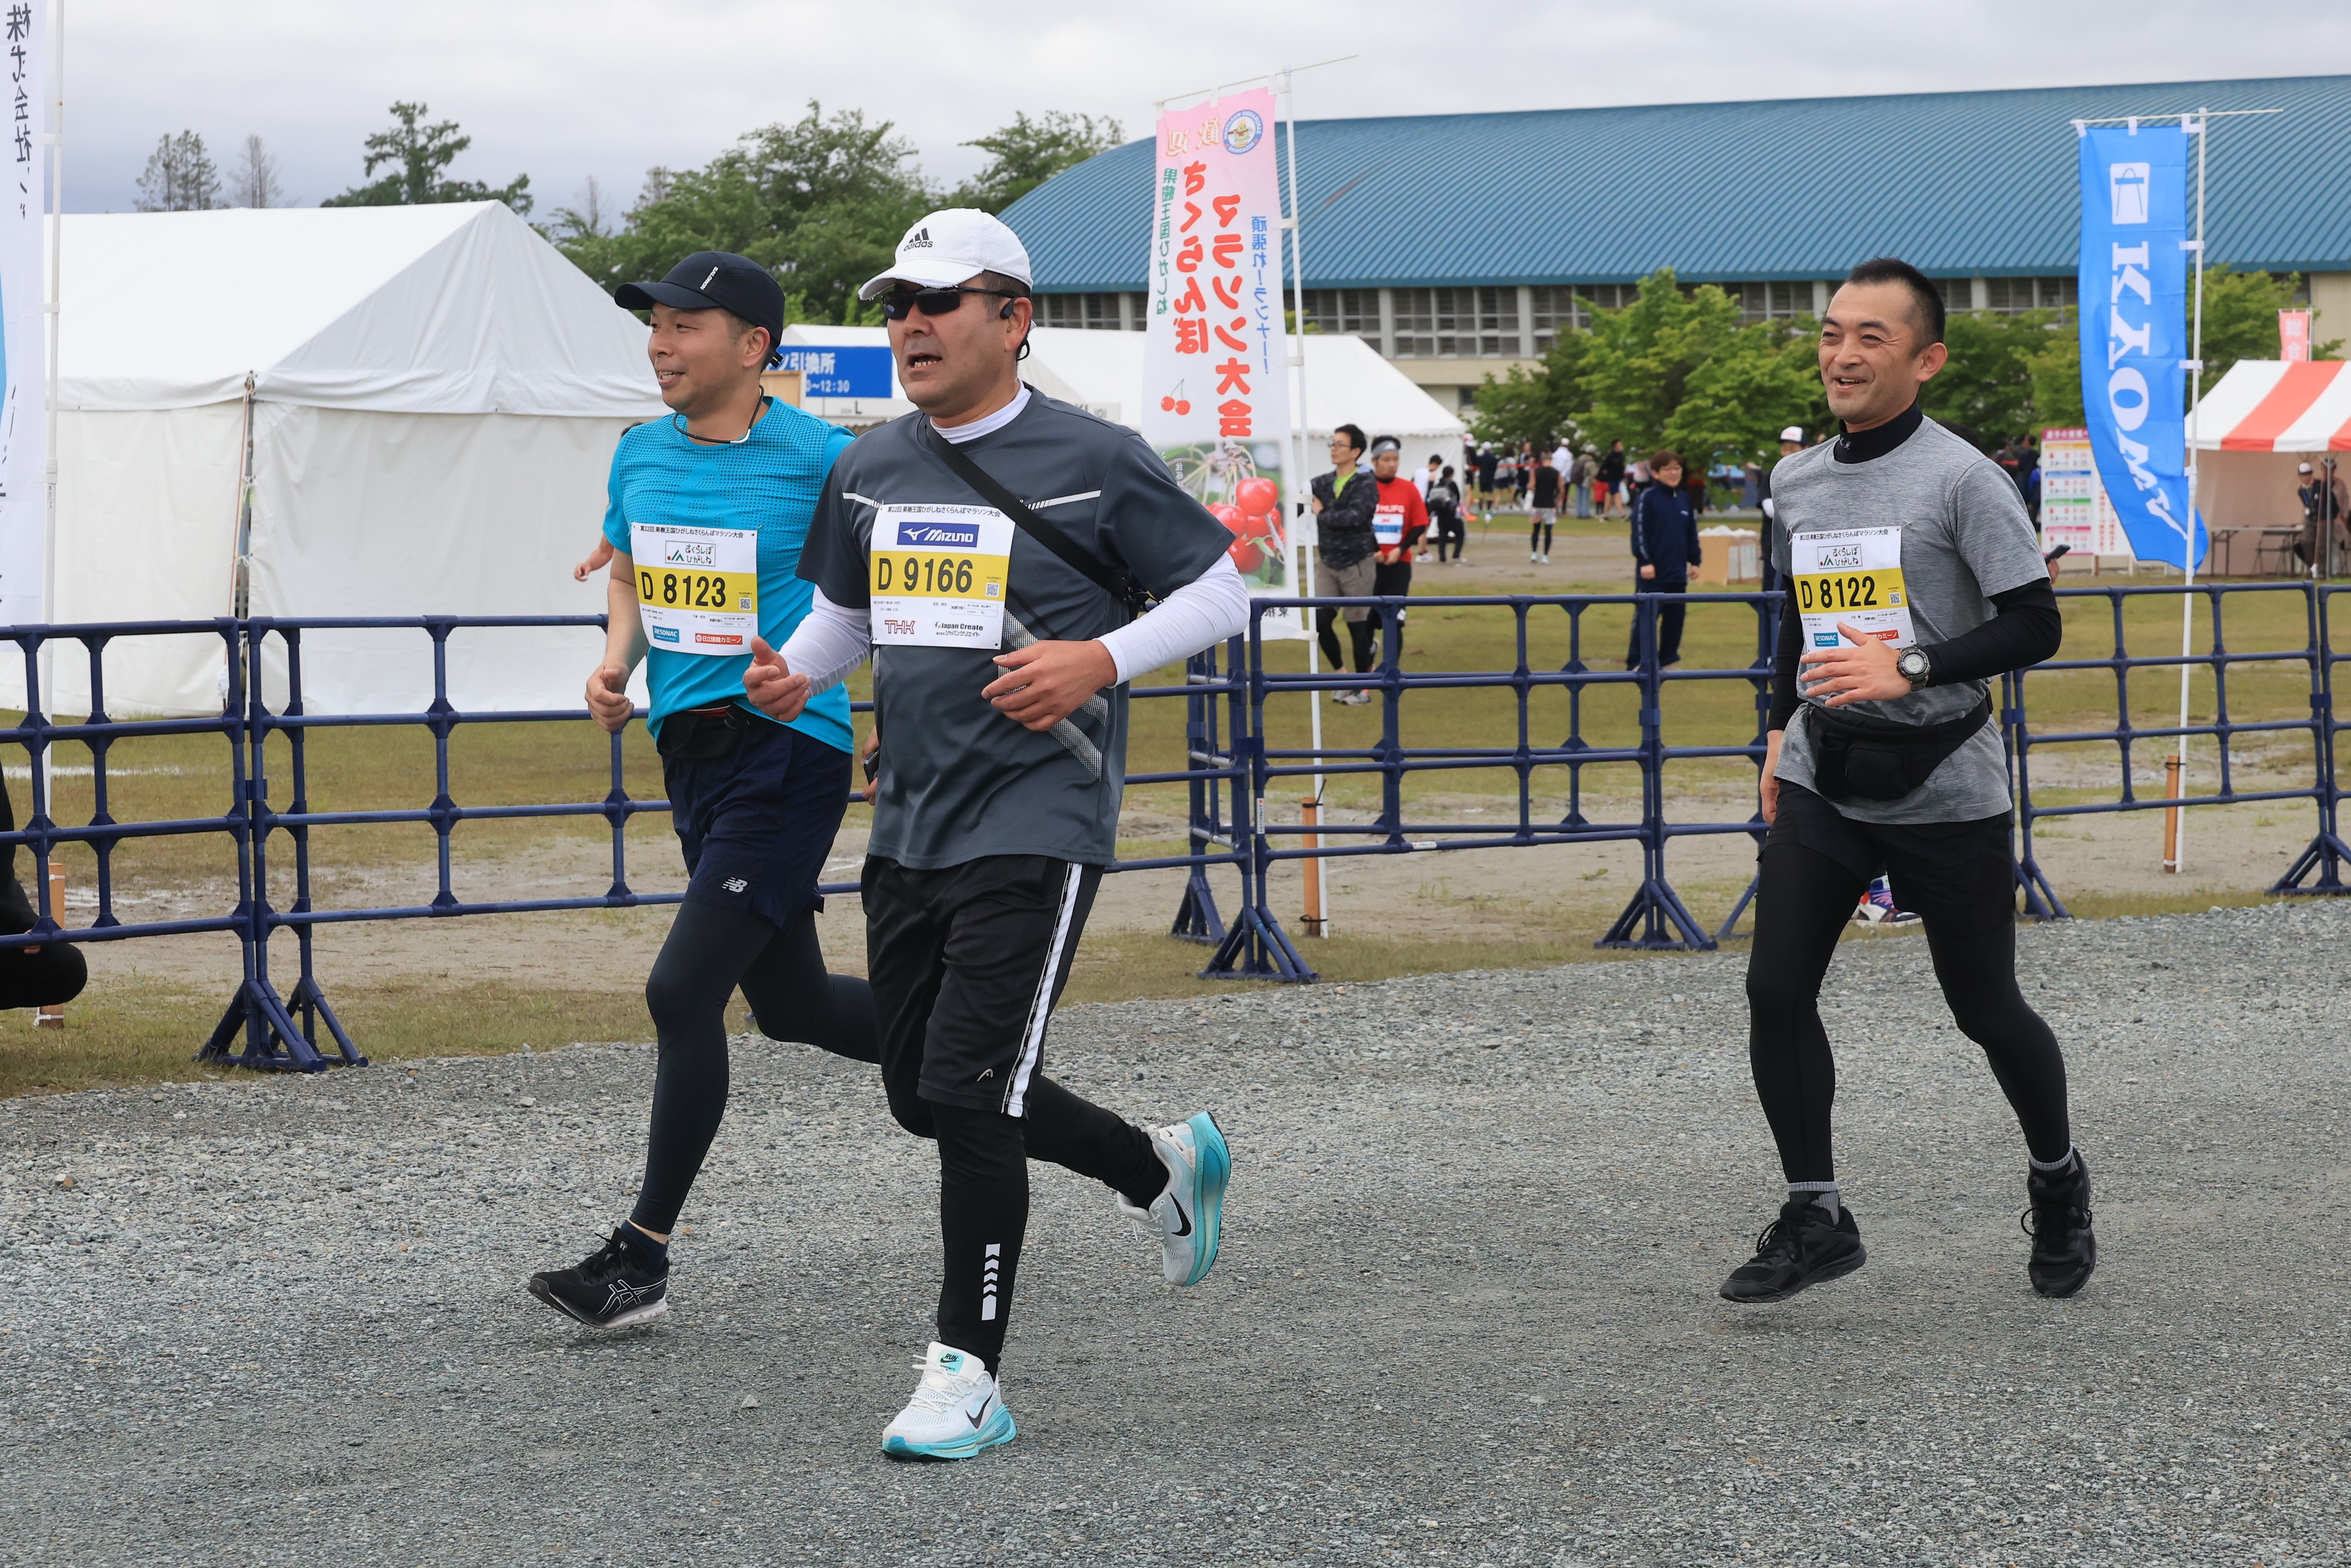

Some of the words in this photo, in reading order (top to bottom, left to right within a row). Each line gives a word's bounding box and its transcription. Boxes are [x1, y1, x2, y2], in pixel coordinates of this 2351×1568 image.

[903, 239, 933, 252] adidas
[700, 266, 719, 291] SALOMON
[902, 506, 1001, 517] 果樹王国ひがしねさくらんぼマラソン大会
[640, 525, 655, 533] 第22回
[655, 526, 744, 539] 果樹王国ひがしねさくらんぼマラソン大会
[1810, 529, 1889, 541] 果樹王国ひがしねさくらんぼマラソン大会
[685, 544, 714, 555] さくらんぼ
[1832, 546, 1859, 557] さくらんぼ
[686, 555, 713, 565] ひがしね
[1834, 557, 1859, 566] ひがしね
[878, 558, 892, 591] D
[904, 557, 974, 594] 9166
[641, 571, 654, 601] D
[663, 573, 726, 608] 8123
[1800, 580, 1813, 609] D
[1819, 576, 1877, 608] 8122
[654, 627, 677, 638] RESONAC
[885, 620, 916, 635] THK
[945, 1353, 958, 1361] RUN
